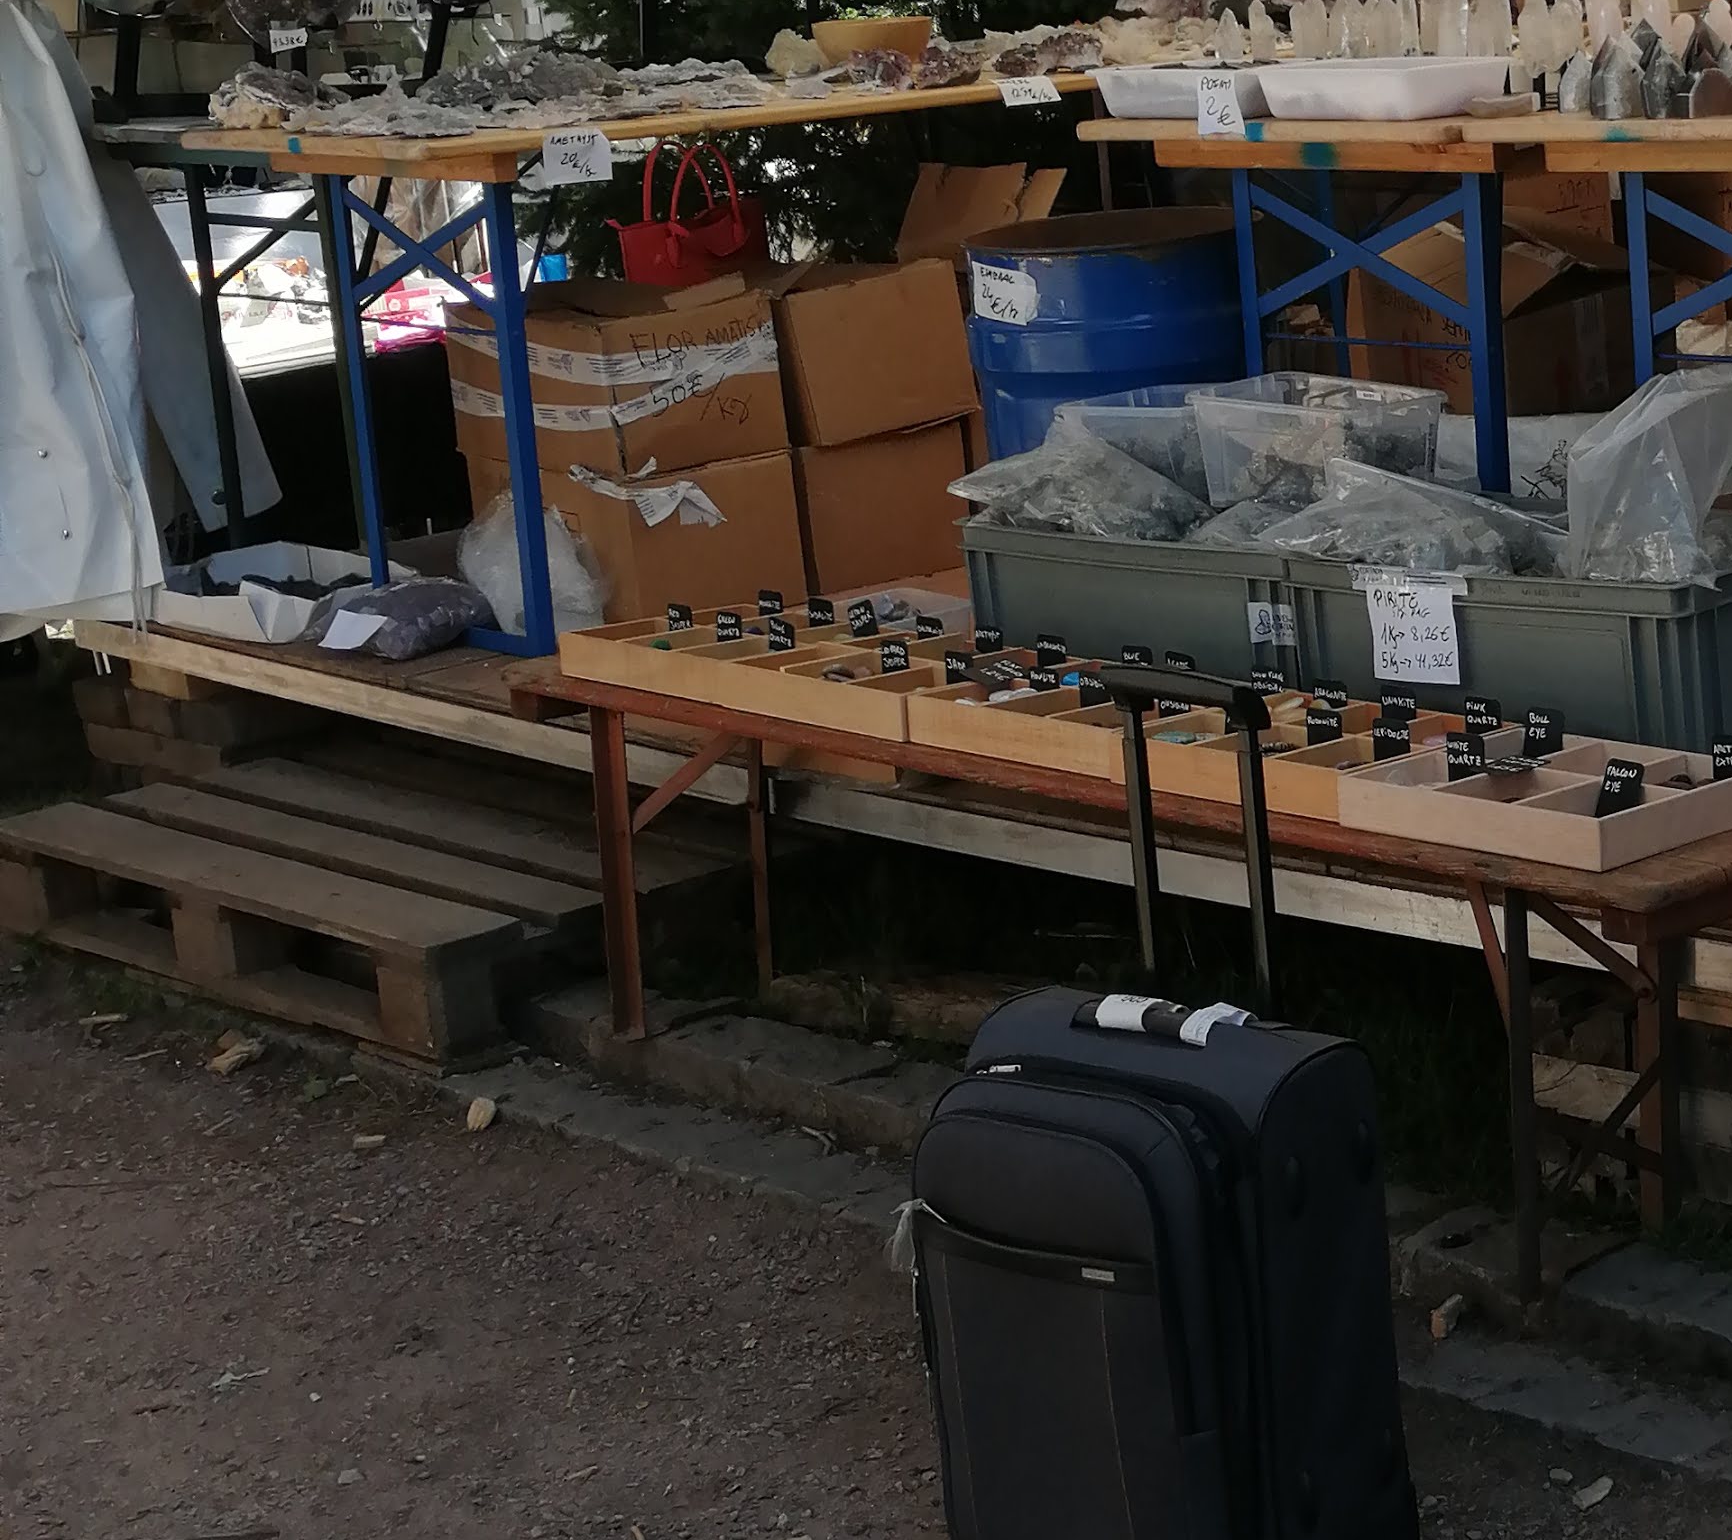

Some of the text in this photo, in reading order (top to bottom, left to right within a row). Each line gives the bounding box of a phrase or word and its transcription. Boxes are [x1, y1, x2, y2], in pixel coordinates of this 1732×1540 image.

[628, 330, 698, 369] FLOR
[1465, 701, 1486, 715] PINK
[1467, 715, 1498, 728] QUARTZ
[1529, 712, 1551, 725] BULL
[1529, 726, 1547, 740] EYE
[1448, 753, 1482, 768] QUARTZ
[1606, 764, 1638, 780] FALCON
[1604, 779, 1622, 794] EYE
